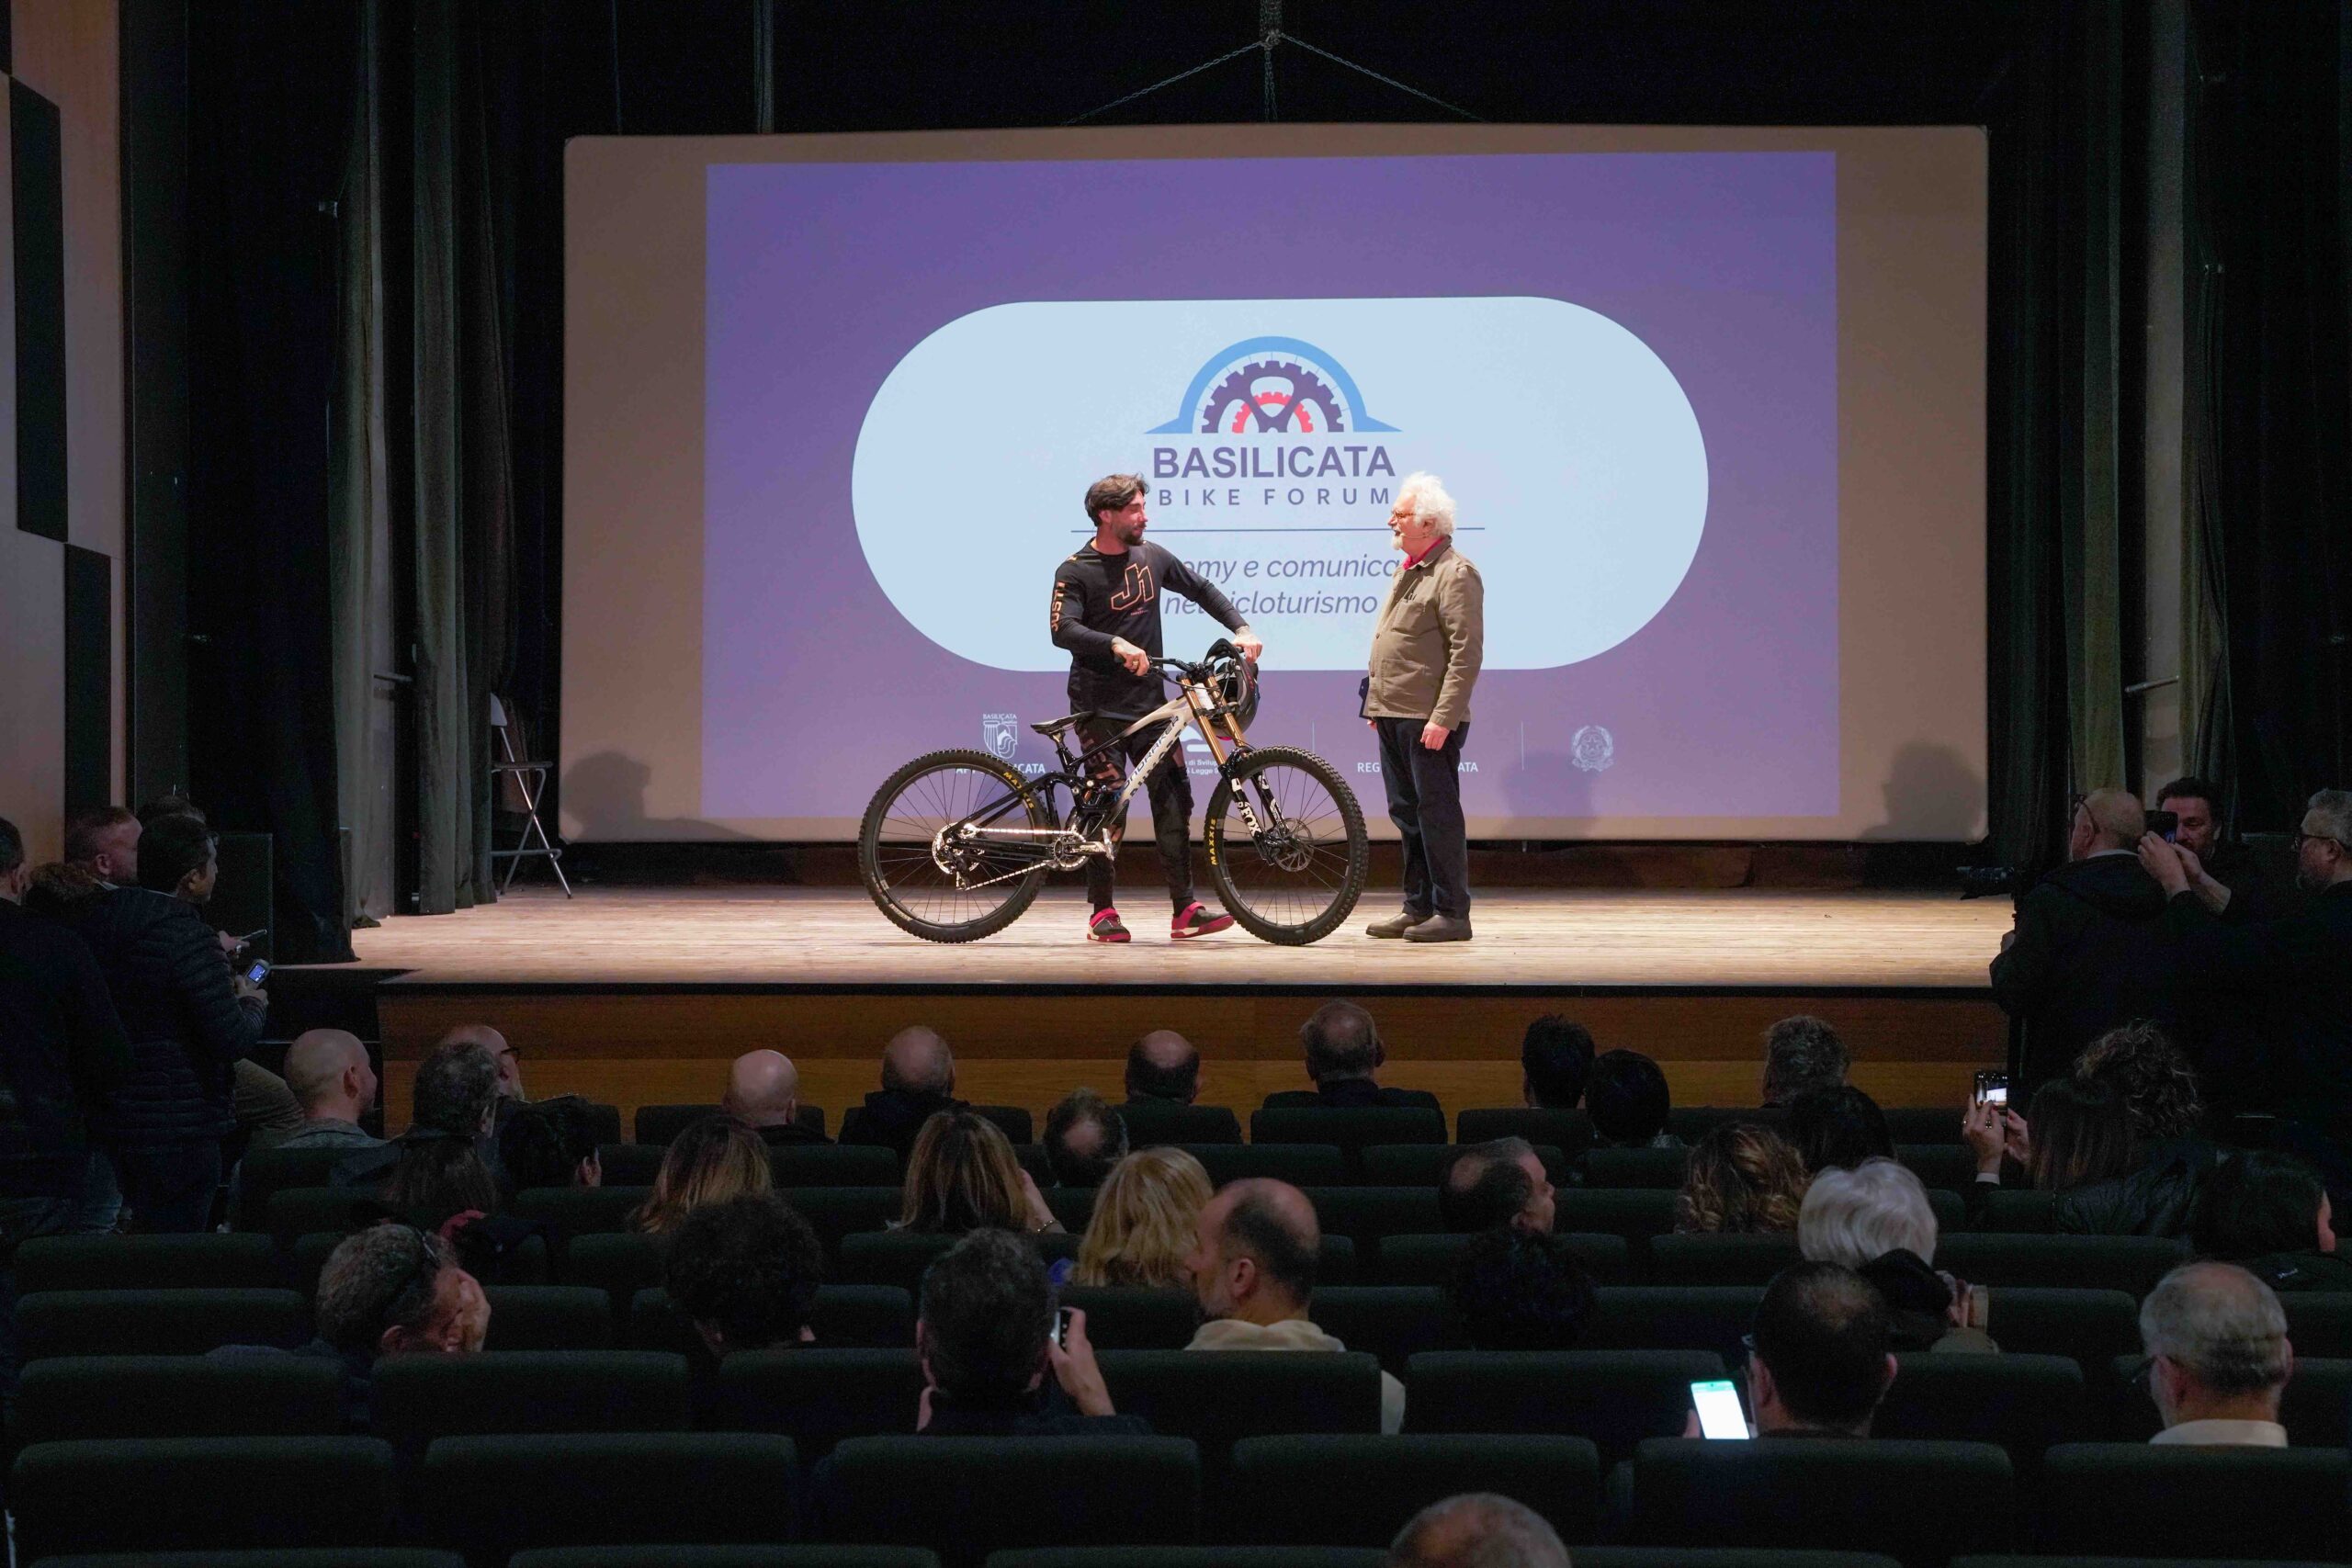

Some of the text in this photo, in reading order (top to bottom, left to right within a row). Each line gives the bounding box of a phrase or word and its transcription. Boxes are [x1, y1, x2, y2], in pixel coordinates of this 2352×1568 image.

[1153, 446, 1396, 479] BASILICATA
[1159, 488, 1390, 506] BIKE FORUM
[1243, 559, 1260, 578] e
[1267, 553, 1400, 578] comunica
[1165, 596, 1204, 615] ne
[1229, 590, 1378, 615] icloturismo
[1208, 818, 1218, 866] MAXXIS
